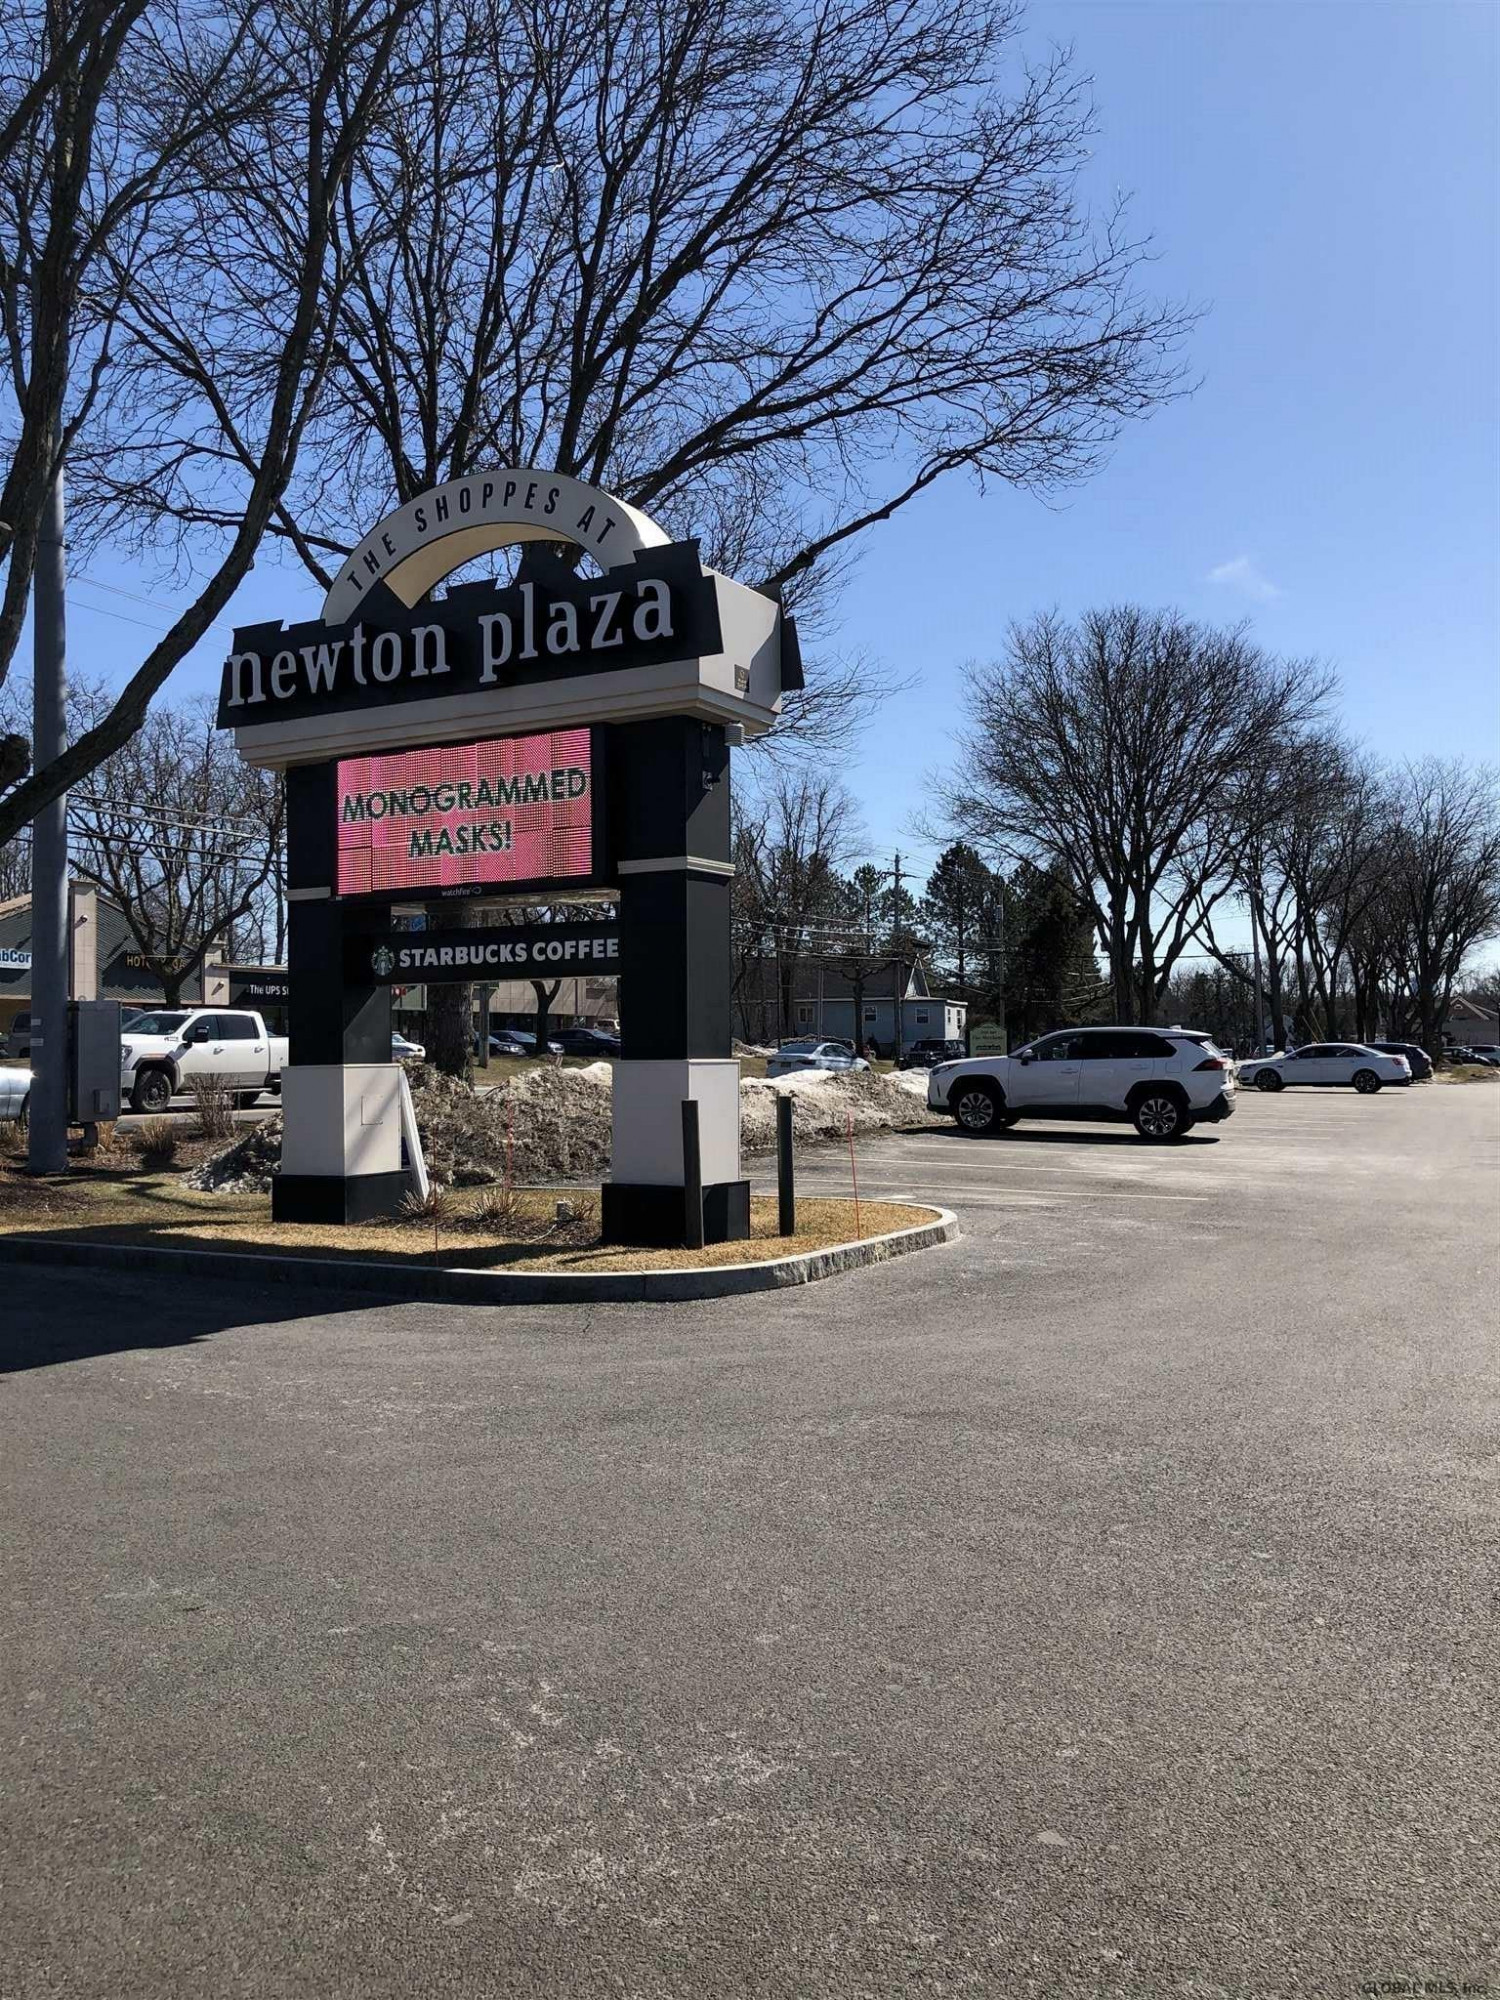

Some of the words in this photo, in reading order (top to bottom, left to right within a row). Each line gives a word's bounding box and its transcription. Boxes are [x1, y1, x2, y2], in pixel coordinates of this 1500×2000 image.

[346, 532, 397, 592] THE
[414, 480, 560, 533] SHOPPES
[576, 505, 616, 544] AT
[226, 621, 450, 707] newton
[478, 578, 674, 684] plaza
[342, 767, 587, 823] MONOGRAMMED
[409, 821, 512, 859] MASKS!
[0, 949, 31, 963] bCor
[400, 942, 526, 968] STARBUCKS
[532, 938, 619, 962] COFFEE
[250, 984, 264, 995] The
[265, 985, 281, 995] UPS
